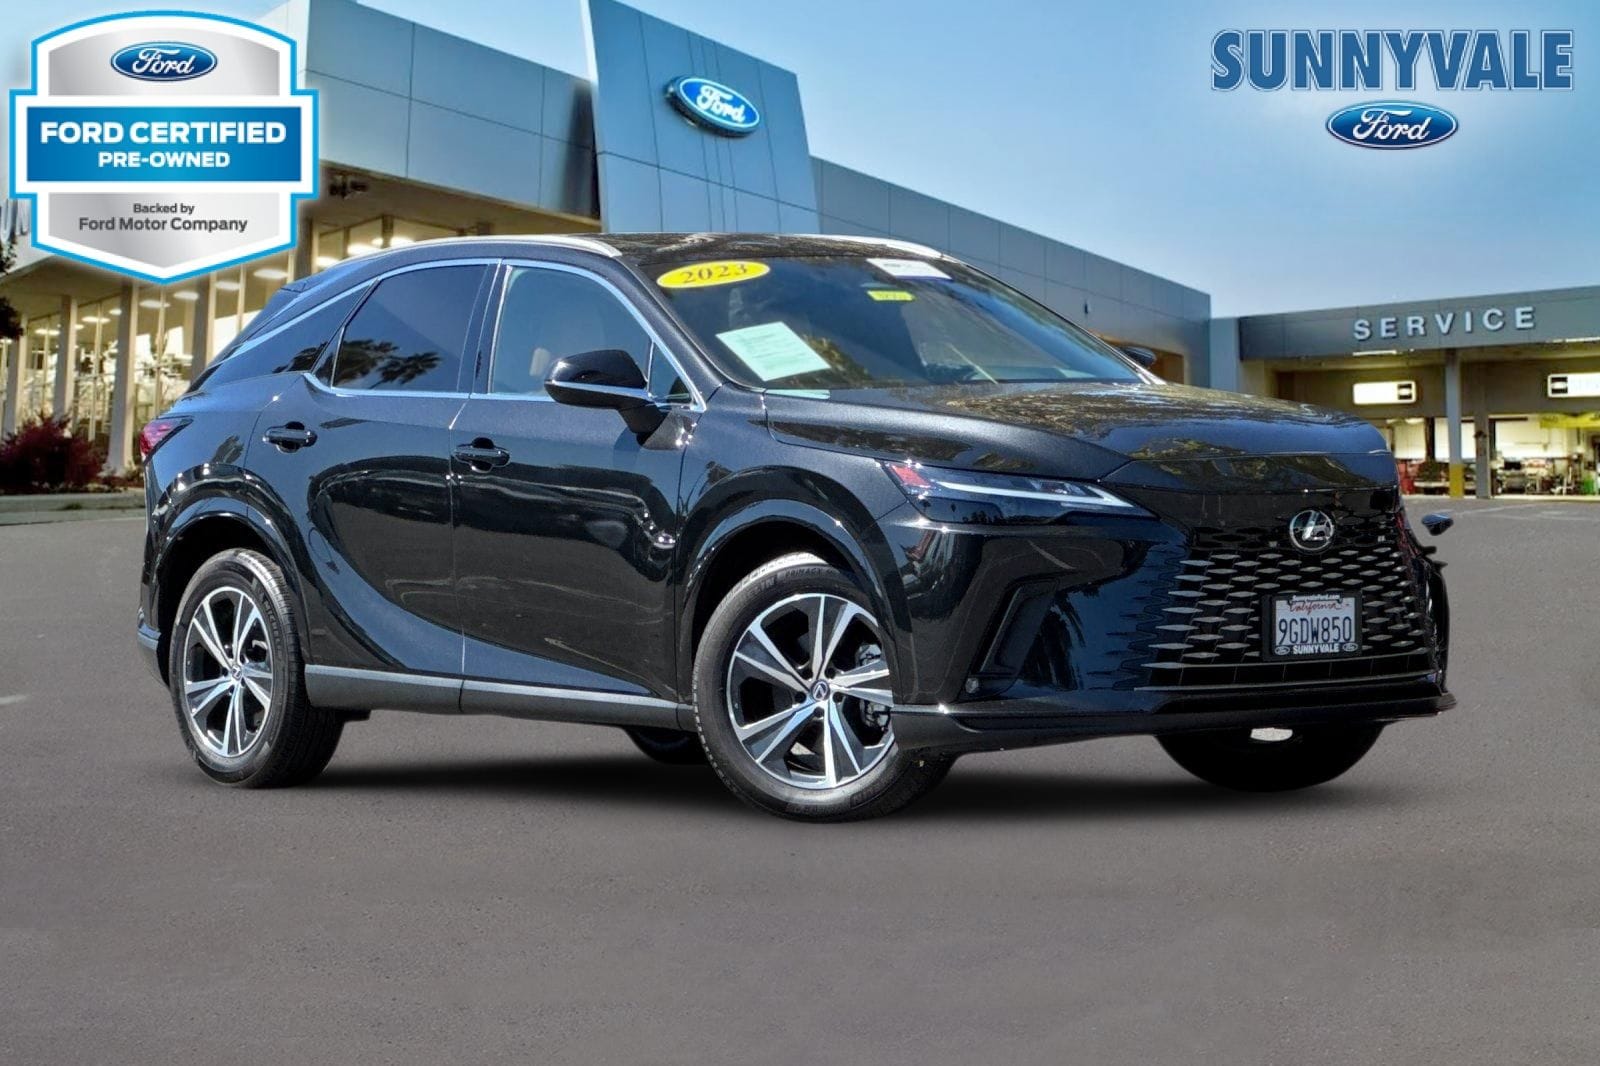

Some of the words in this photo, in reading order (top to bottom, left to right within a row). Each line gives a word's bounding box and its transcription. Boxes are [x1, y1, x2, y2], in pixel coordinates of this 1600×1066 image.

[696, 84, 746, 123] Ford
[680, 264, 748, 284] 2023
[1353, 306, 1535, 341] SERVICE
[1289, 601, 1342, 616] California
[1278, 616, 1352, 646] 9GDW850
[1292, 643, 1340, 655] SUNNYVALE
